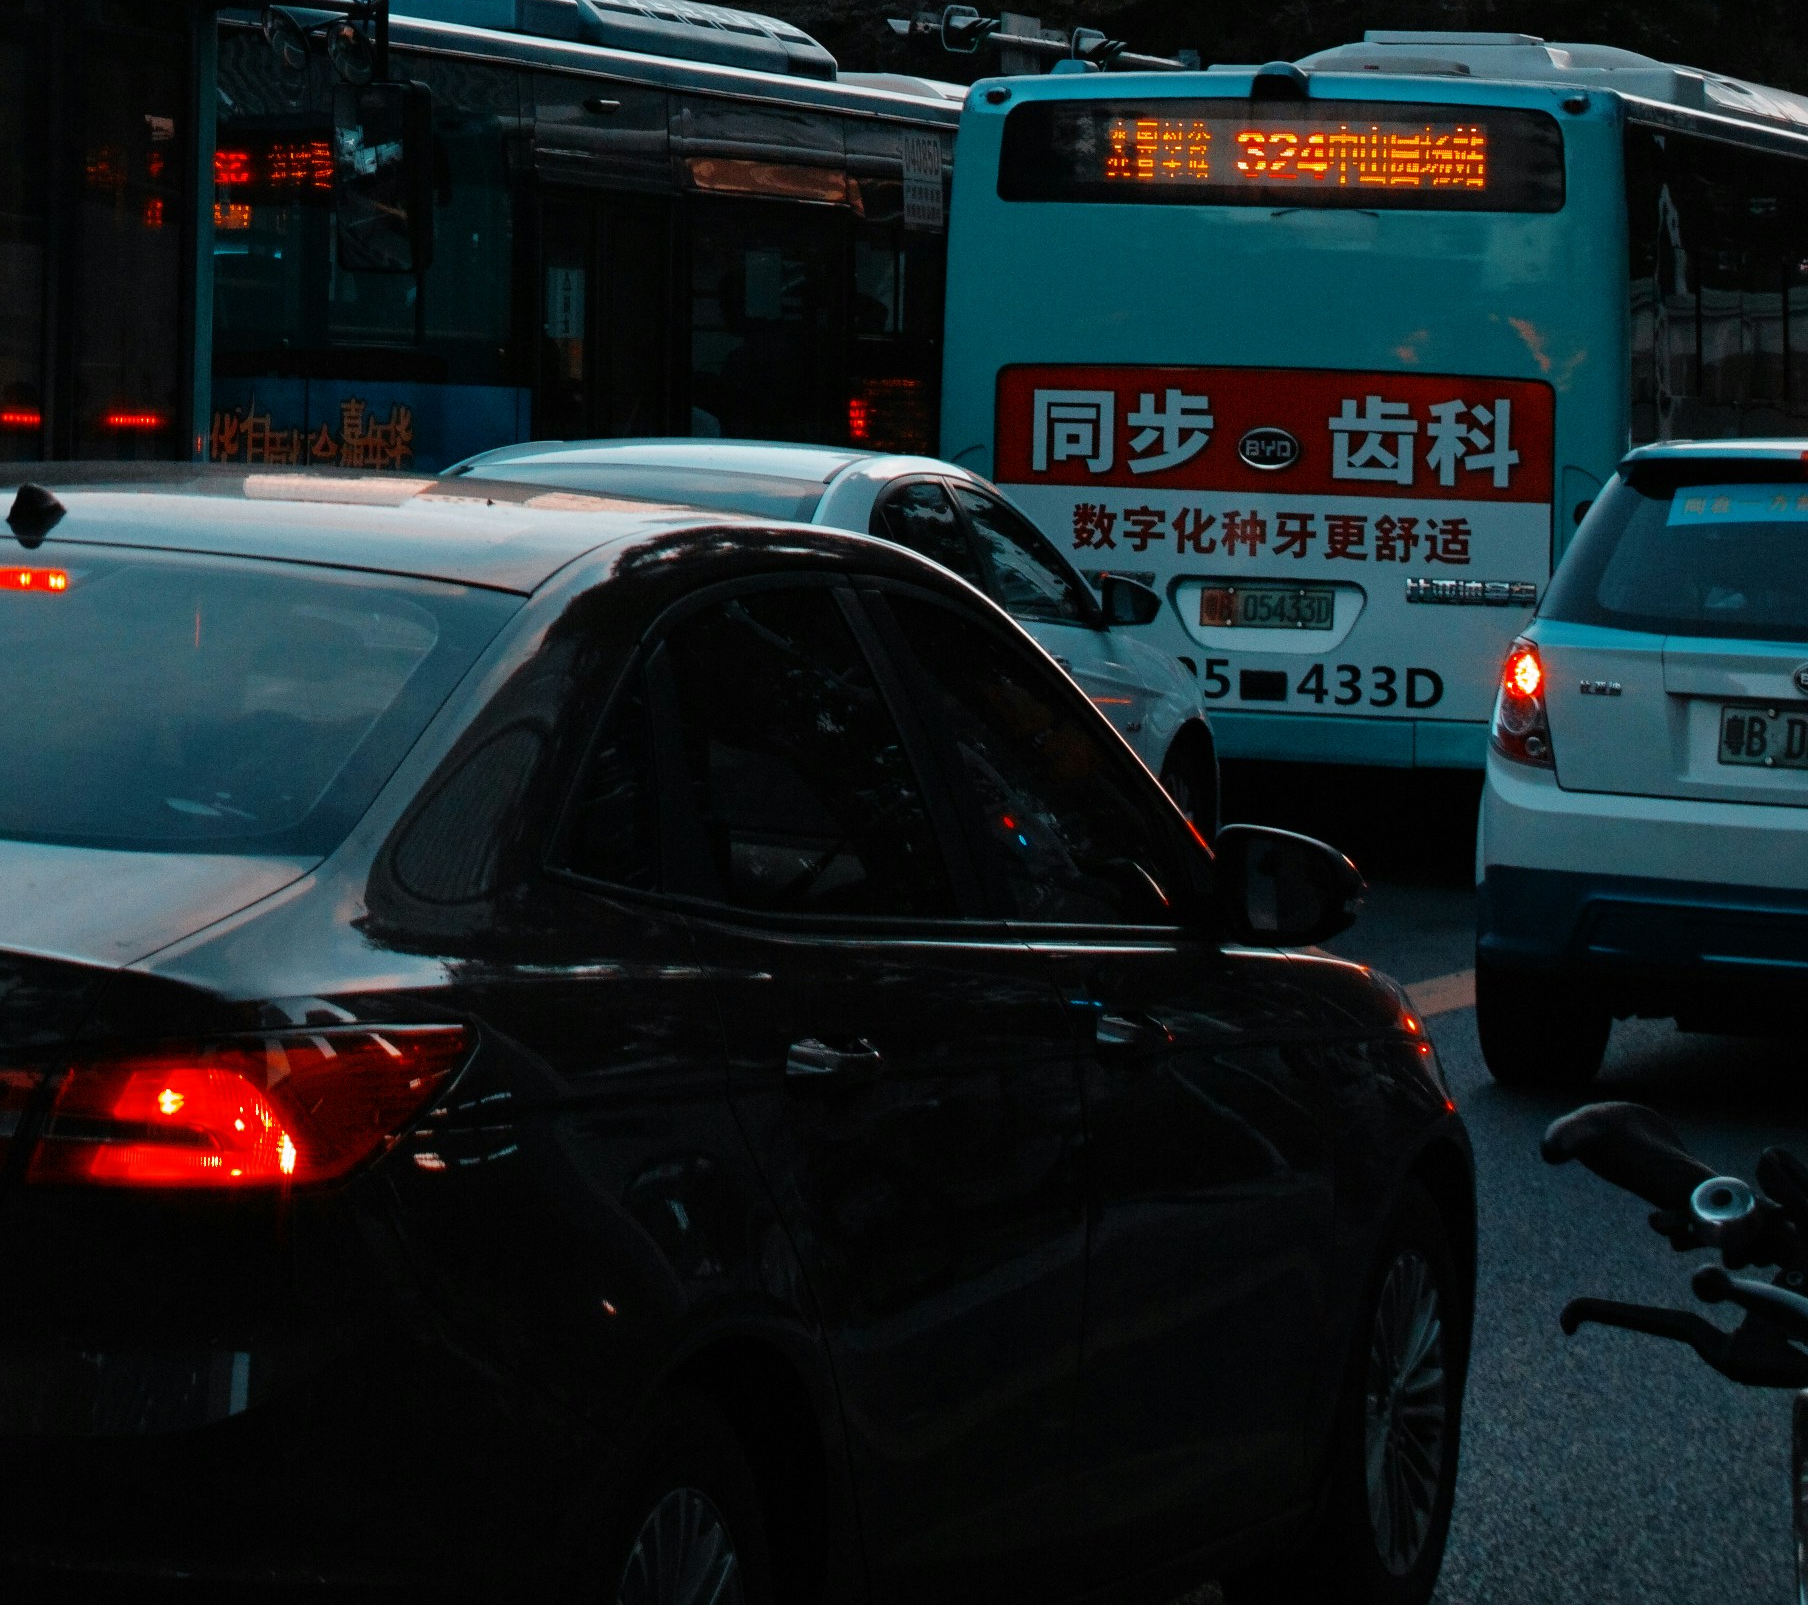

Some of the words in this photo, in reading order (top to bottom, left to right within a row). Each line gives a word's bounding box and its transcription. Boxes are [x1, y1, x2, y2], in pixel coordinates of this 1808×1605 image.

[1032, 387, 1214, 475] 同步
[1328, 394, 1521, 489] 齿科
[1244, 438, 1292, 459] BYD
[1072, 503, 1472, 565] 数字化种牙更舒适
[1243, 594, 1330, 624] 05433D
